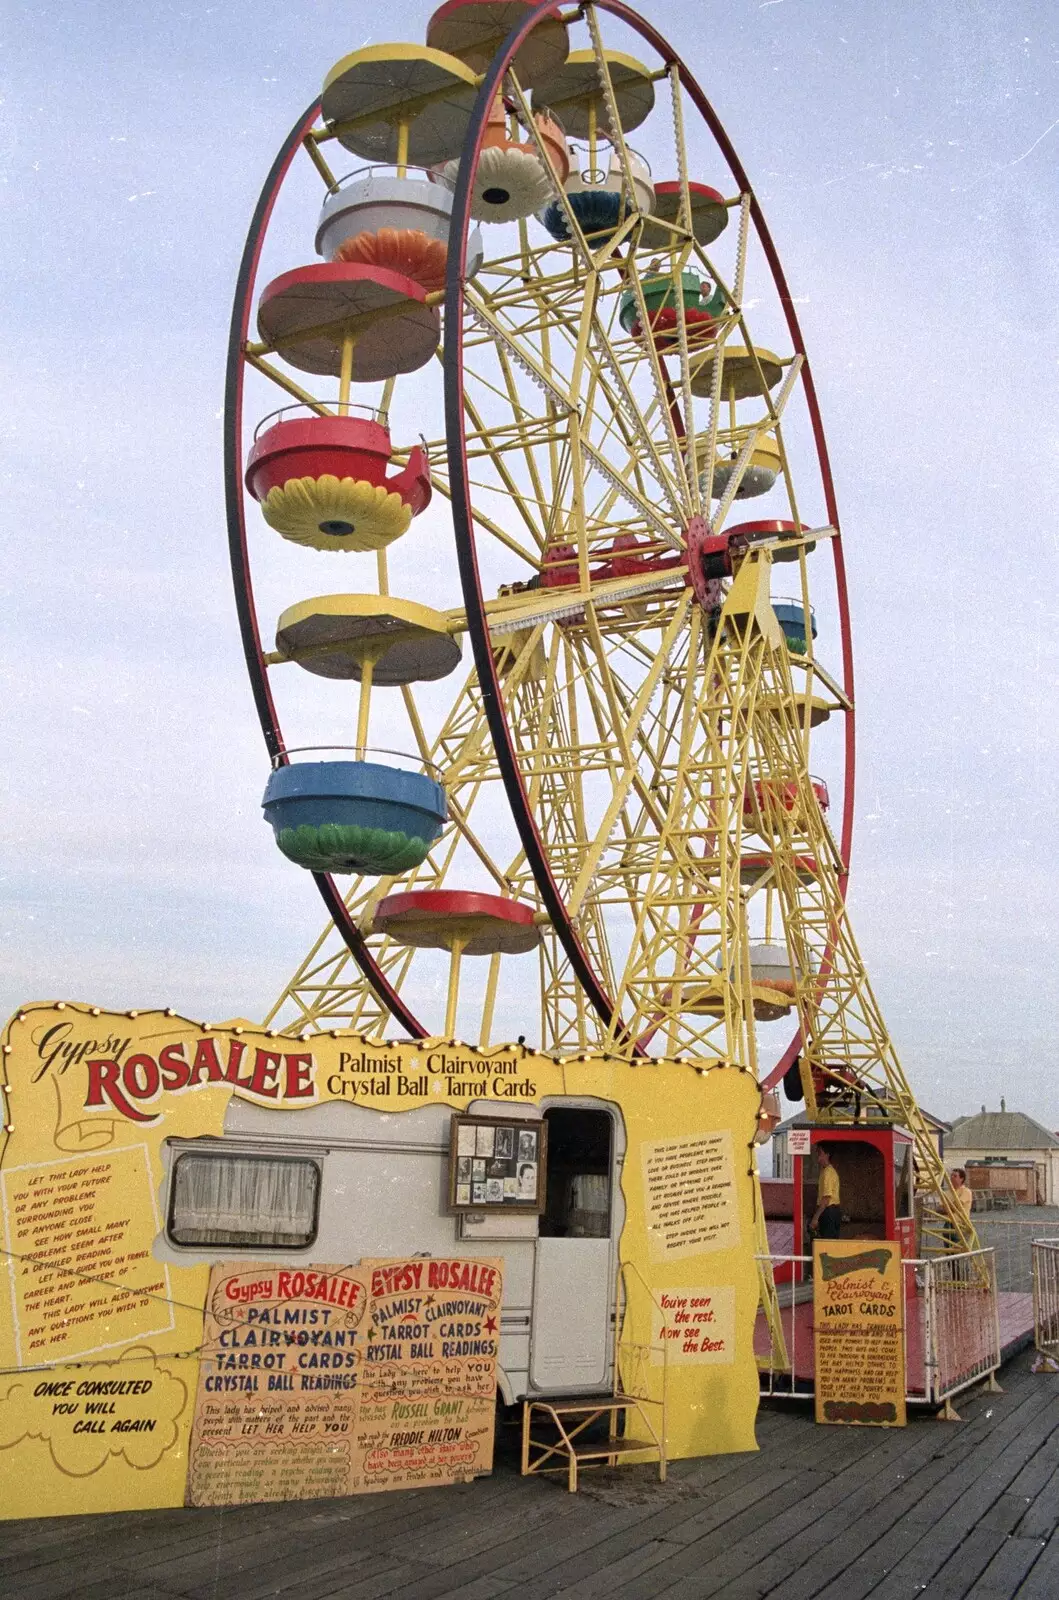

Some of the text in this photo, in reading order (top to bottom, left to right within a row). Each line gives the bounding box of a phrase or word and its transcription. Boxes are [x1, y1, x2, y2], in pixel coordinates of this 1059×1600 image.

[30, 1021, 316, 1124] Gypsy ROSALEE
[338, 1052, 519, 1077] Palmist Clairvoyant
[326, 1076, 537, 1100] Crystal Ball Tarrot Cards
[28, 1164, 111, 1186] LET THIS LADY HELP
[13, 1176, 112, 1201] YOU WITH YOUR FUTURE
[15, 1191, 96, 1213] OR ANY PROBLEMS
[16, 1203, 95, 1226] SURROUNDING YOU
[17, 1229, 28, 1238] OR
[32, 1222, 65, 1235] ANYONE
[35, 1220, 130, 1247] SEE HOW SMALL MANY
[21, 1233, 124, 1262] PROBLEMS SEEM AFTER
[22, 1248, 112, 1275] A DETAILED READING
[39, 1250, 149, 1284] LET HER GUIDE YOU ON TRAVEL
[24, 1287, 54, 1300] CAREER
[58, 1281, 75, 1292] AND
[79, 1270, 114, 1285] MATTERS
[119, 1267, 129, 1277] OF
[371, 1262, 496, 1297] GYPSY ROSALEE
[827, 1277, 875, 1294] Palmist
[225, 1271, 360, 1309] Gypsy ROSALEE
[830, 1289, 895, 1301] Clairvoyant
[25, 1302, 40, 1312] THE
[43, 1282, 164, 1320] THIS LADY WILL ALSO ANSWER
[661, 1294, 711, 1308] You've seen
[28, 1299, 149, 1337] ANY QUESTIONS YOU WISH TO
[248, 1308, 332, 1324] PALMIST
[372, 1298, 488, 1326] PALMIST CLAIRVOYANT
[675, 1309, 716, 1323] the rest.
[822, 1303, 895, 1317] TAROT CARDS
[219, 1330, 358, 1347] CLAIRVOYANT
[382, 1323, 481, 1340] TARROT CARDS
[660, 1326, 700, 1339] Now see
[29, 1338, 46, 1349] ASK
[367, 1340, 495, 1361] RYSTAL BALL READINGS
[683, 1337, 725, 1353] the Best.
[216, 1353, 355, 1370] TARROT CARDS
[446, 1365, 461, 1374] help
[468, 1364, 490, 1372] YOU
[205, 1375, 258, 1392] CRYSTAL
[268, 1375, 293, 1391] BALL
[301, 1373, 357, 1390] READINGS
[466, 1374, 483, 1382] have
[477, 1382, 489, 1390] her
[33, 1380, 153, 1397] ONCE CONSULTED
[51, 1402, 115, 1415] YOU WILL
[206, 1405, 220, 1414] This
[224, 1405, 240, 1415] lady
[244, 1405, 256, 1413] has
[261, 1404, 282, 1415] helped
[287, 1404, 299, 1412] and
[305, 1403, 329, 1412] advised
[391, 1401, 428, 1420] RUSSELL
[434, 1398, 464, 1417] GRANT
[289, 1414, 299, 1422] the
[340, 1413, 351, 1421] the
[73, 1420, 156, 1434] CALL AGAIN
[201, 1423, 348, 1438] present LET HER HELP YOU
[390, 1431, 424, 1446] FREDDIE
[428, 1428, 462, 1443] HILTON
